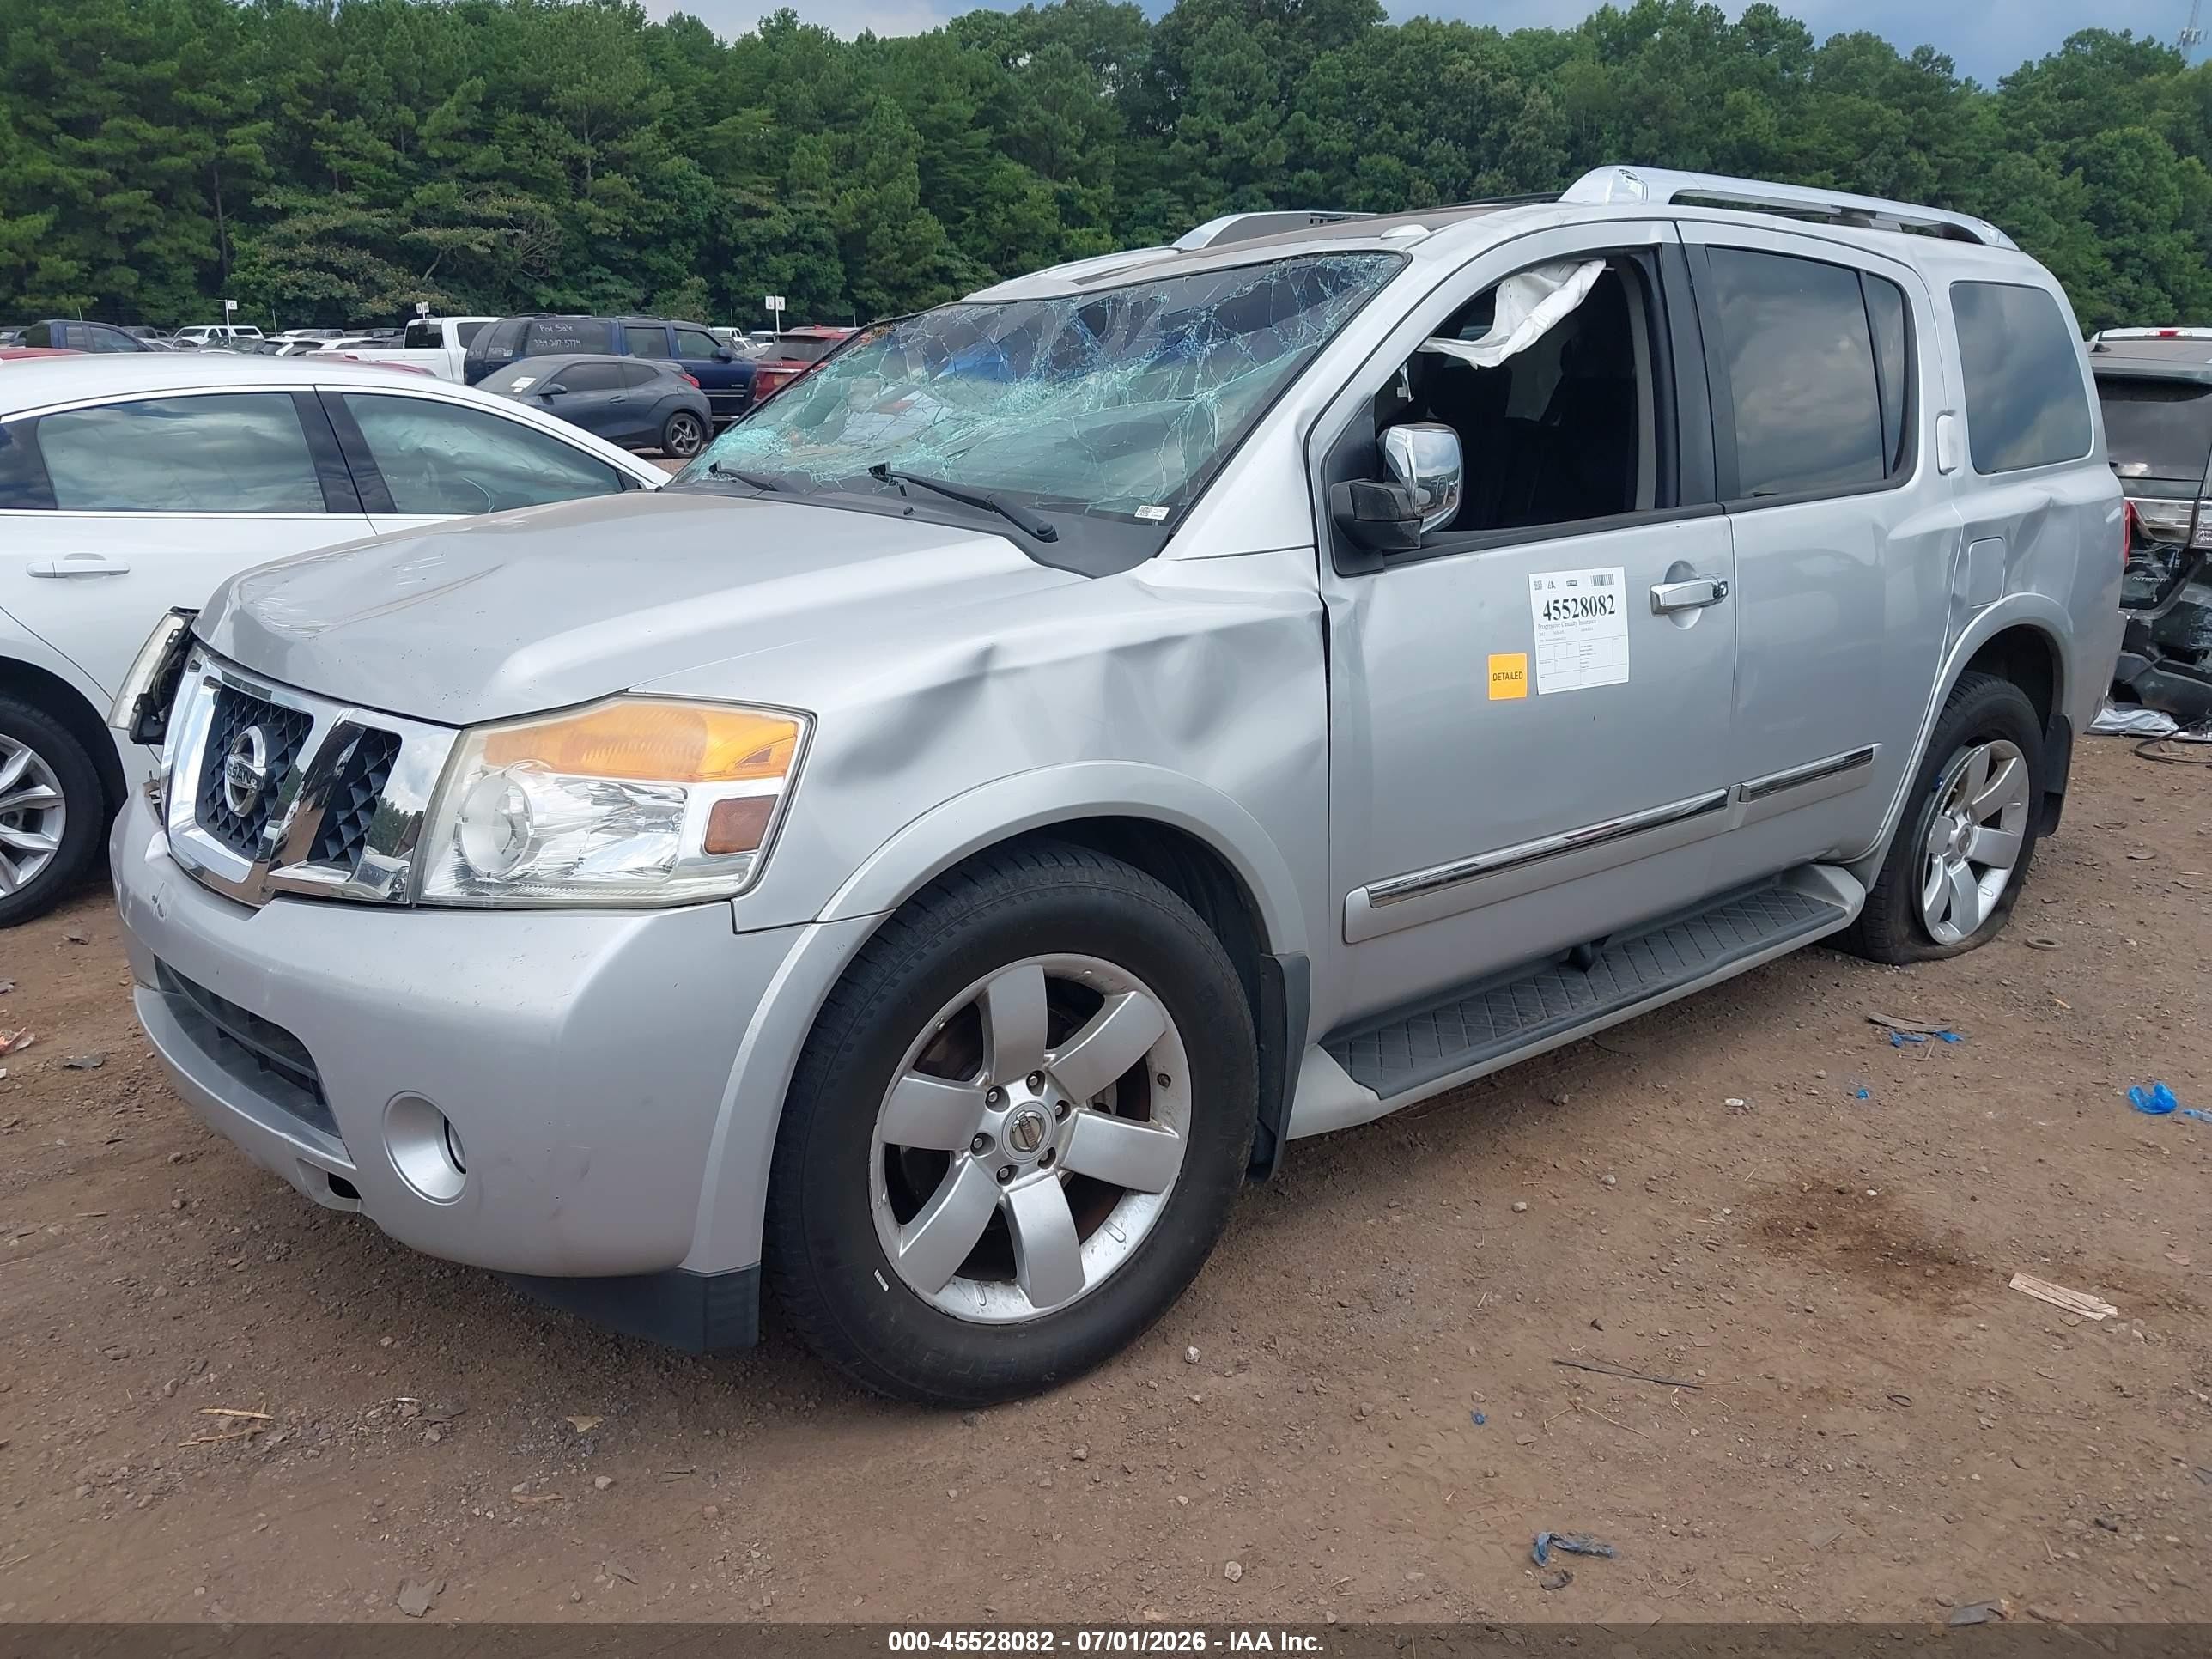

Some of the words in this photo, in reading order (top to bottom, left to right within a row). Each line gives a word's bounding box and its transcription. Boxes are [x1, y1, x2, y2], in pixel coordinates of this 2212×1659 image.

[538, 324, 553, 332] For
[555, 323, 573, 332] Sale
[1543, 594, 1615, 621] 45528082
[1492, 672, 1523, 681] DETAILED
